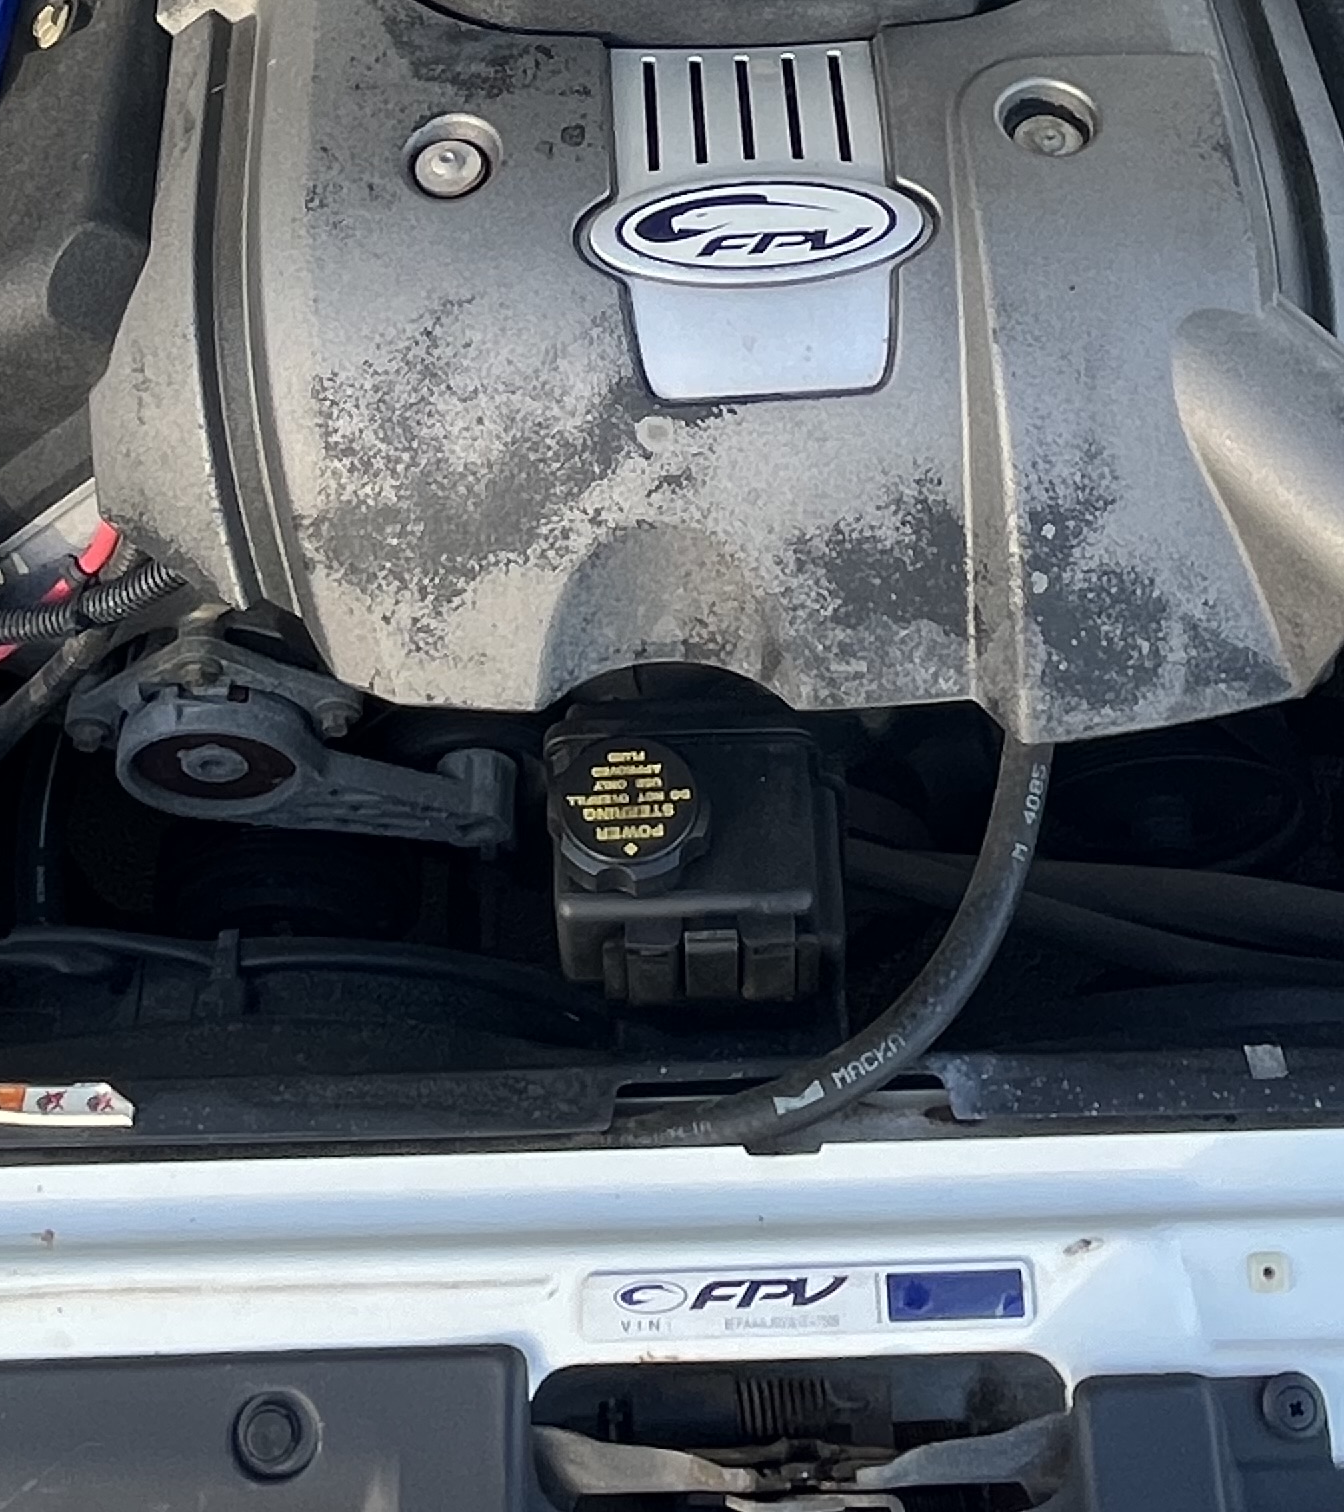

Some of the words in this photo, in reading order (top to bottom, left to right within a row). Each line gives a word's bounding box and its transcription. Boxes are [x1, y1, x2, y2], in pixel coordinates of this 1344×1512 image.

[696, 226, 873, 257] FPV
[596, 822, 664, 840] POWER
[689, 1275, 849, 1312] FPV
